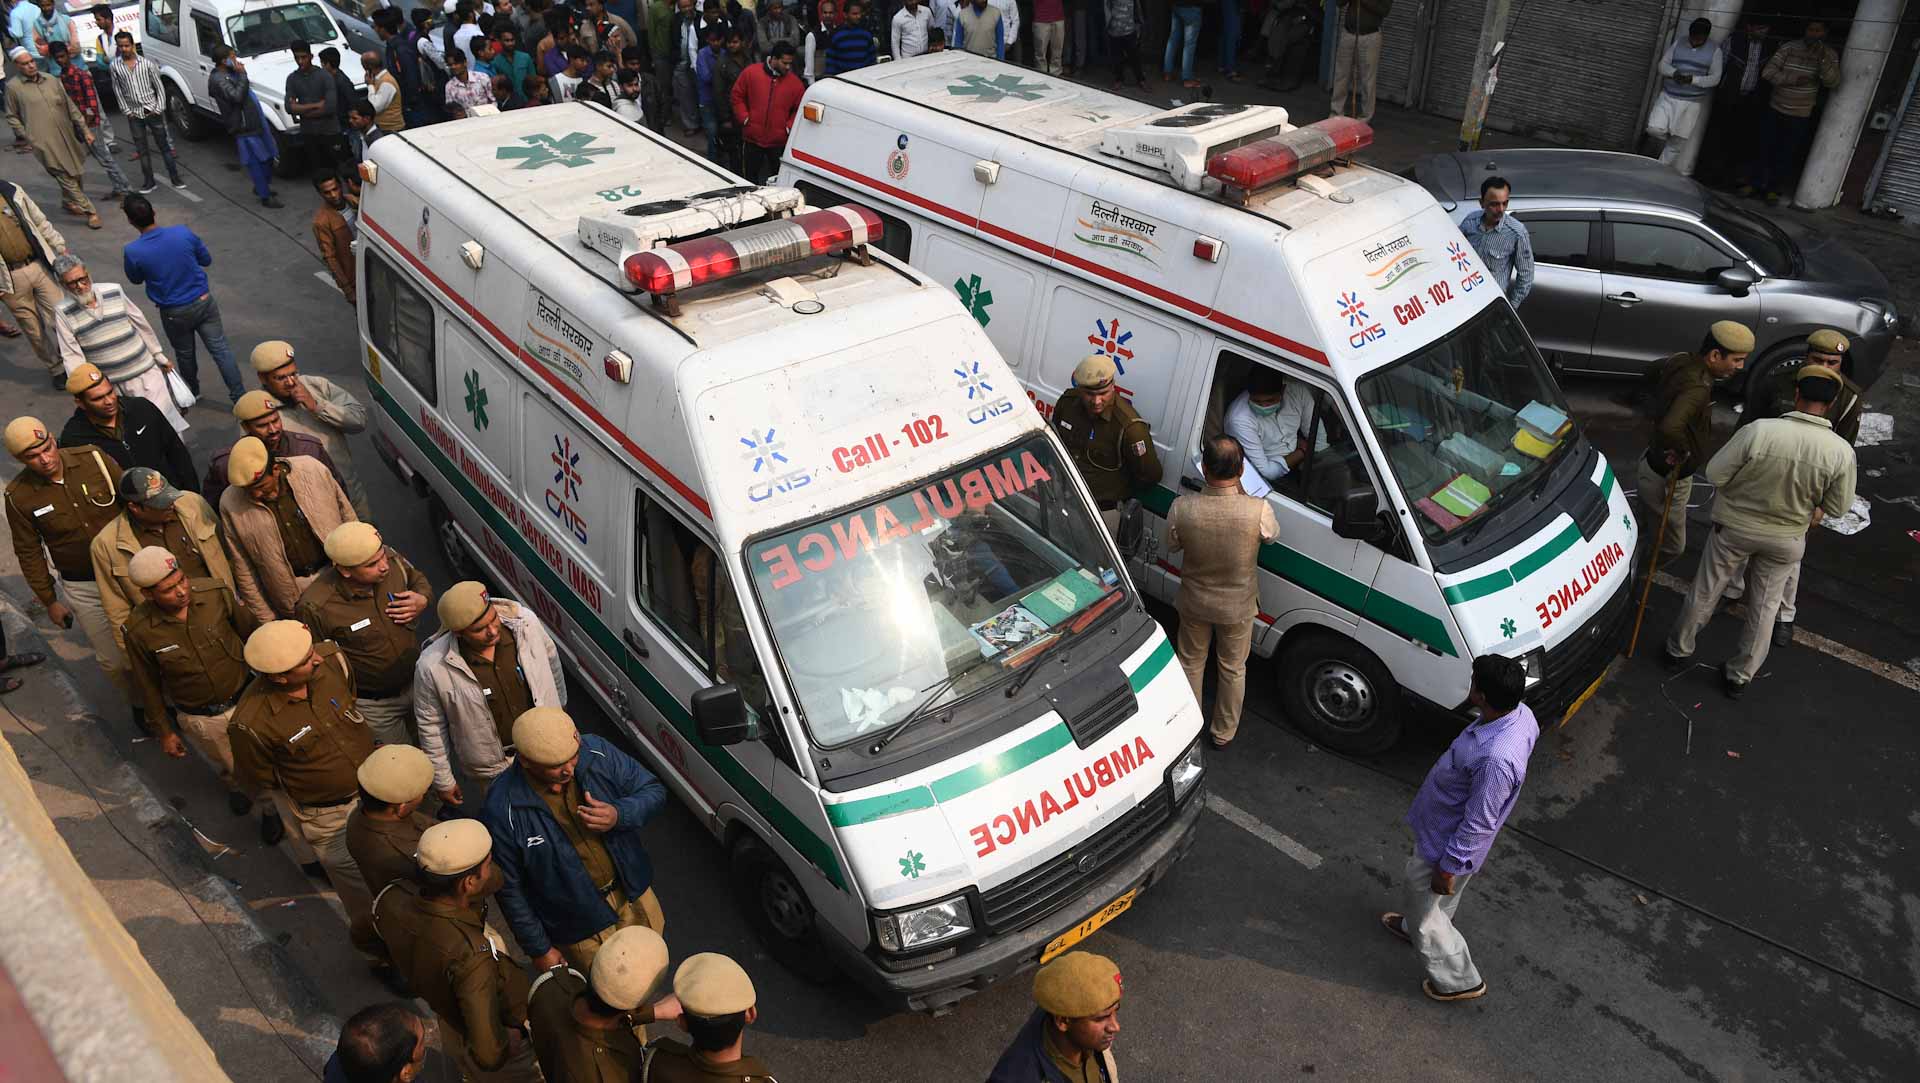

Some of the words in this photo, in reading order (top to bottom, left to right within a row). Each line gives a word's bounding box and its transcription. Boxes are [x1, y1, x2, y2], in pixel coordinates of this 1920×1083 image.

[1142, 143, 1165, 157] BHPL
[1091, 200, 1119, 223] दिल्ली
[1119, 211, 1157, 237] सरकार
[1121, 238, 1143, 253] सरकार
[1386, 235, 1412, 254] सरकार
[1461, 271, 1484, 292] CATS
[1393, 294, 1426, 326] Call
[1428, 280, 1454, 306] 102
[537, 296, 561, 332] दिल्ली
[561, 320, 594, 357] सरकार
[1349, 323, 1386, 349] CATS
[966, 396, 1013, 425] CATS
[832, 433, 891, 474] Call
[901, 414, 949, 448] 102
[420, 404, 456, 459] National
[460, 448, 518, 526] Ambulance
[520, 509, 563, 574] Service
[748, 468, 811, 503] CATS
[546, 488, 587, 544] CATS
